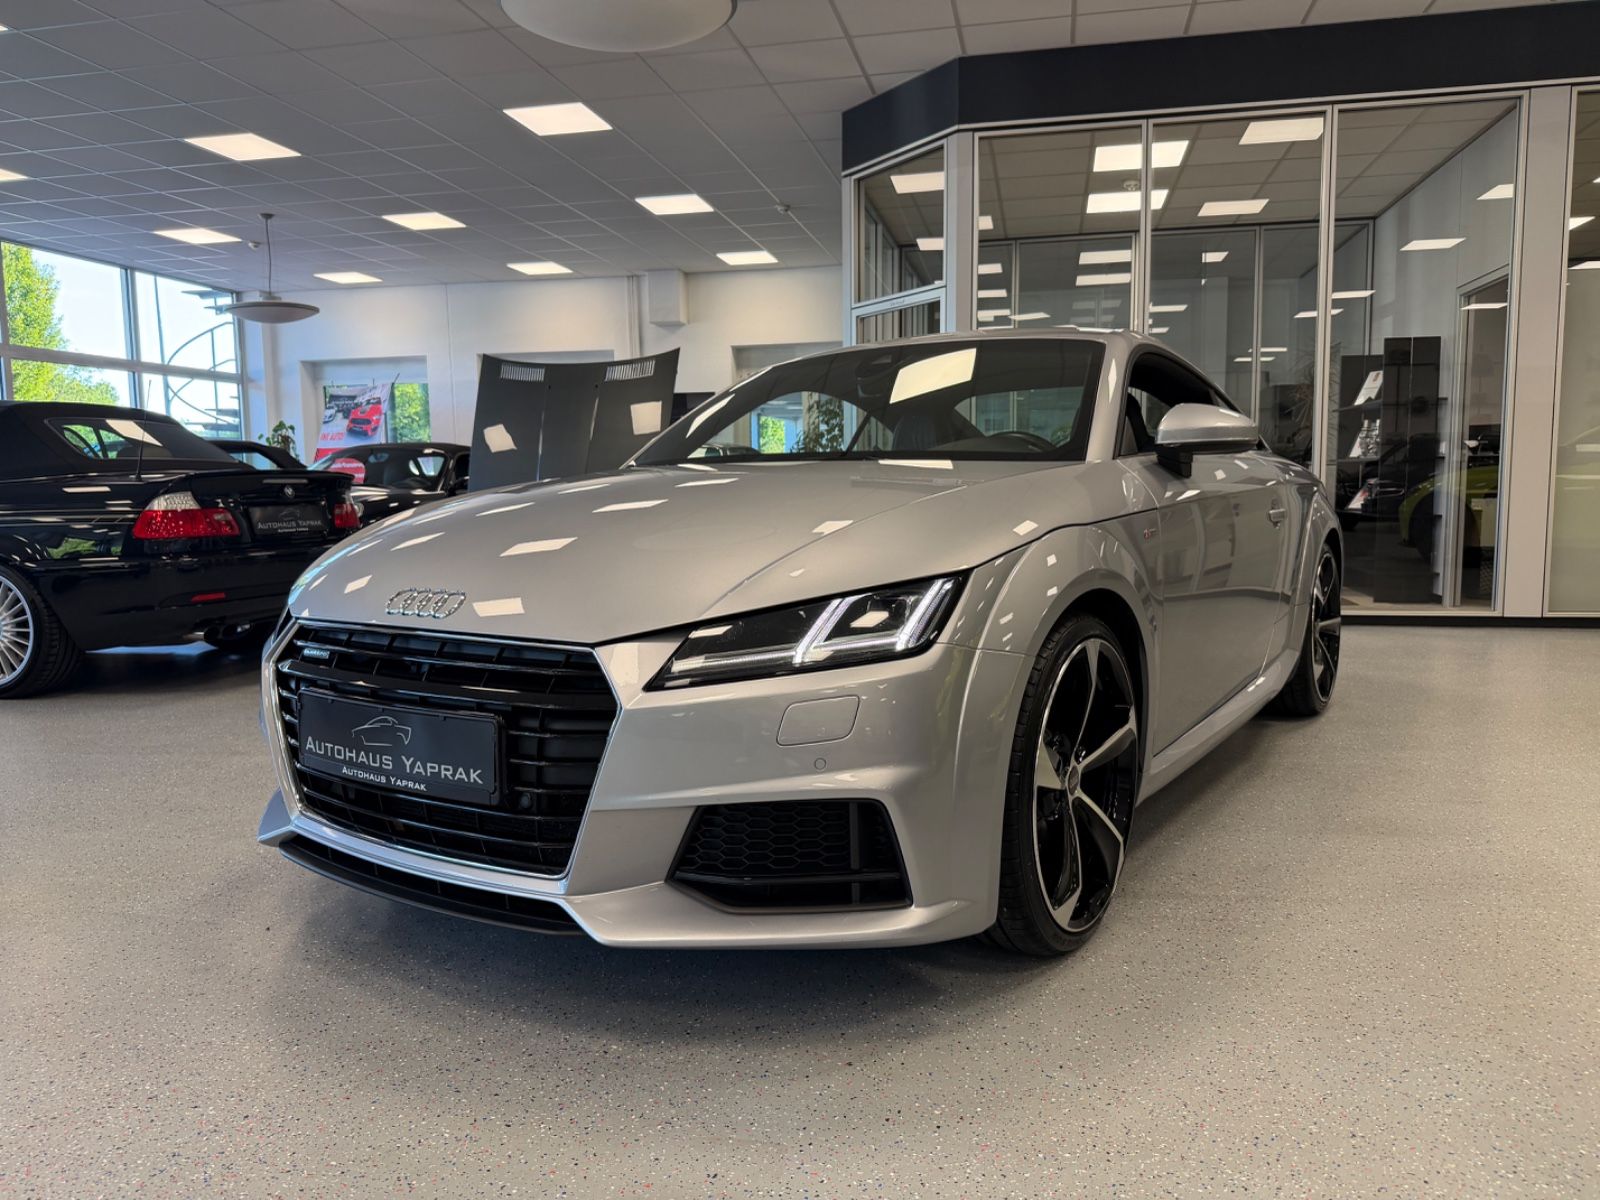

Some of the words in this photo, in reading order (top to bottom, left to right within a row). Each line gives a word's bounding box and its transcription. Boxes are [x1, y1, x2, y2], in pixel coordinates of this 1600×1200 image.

[305, 736, 393, 770] AUTOHAUS
[401, 755, 483, 785] YAPRAK
[342, 766, 387, 783] AUTOHAUS
[389, 776, 428, 792] YAPRAK
